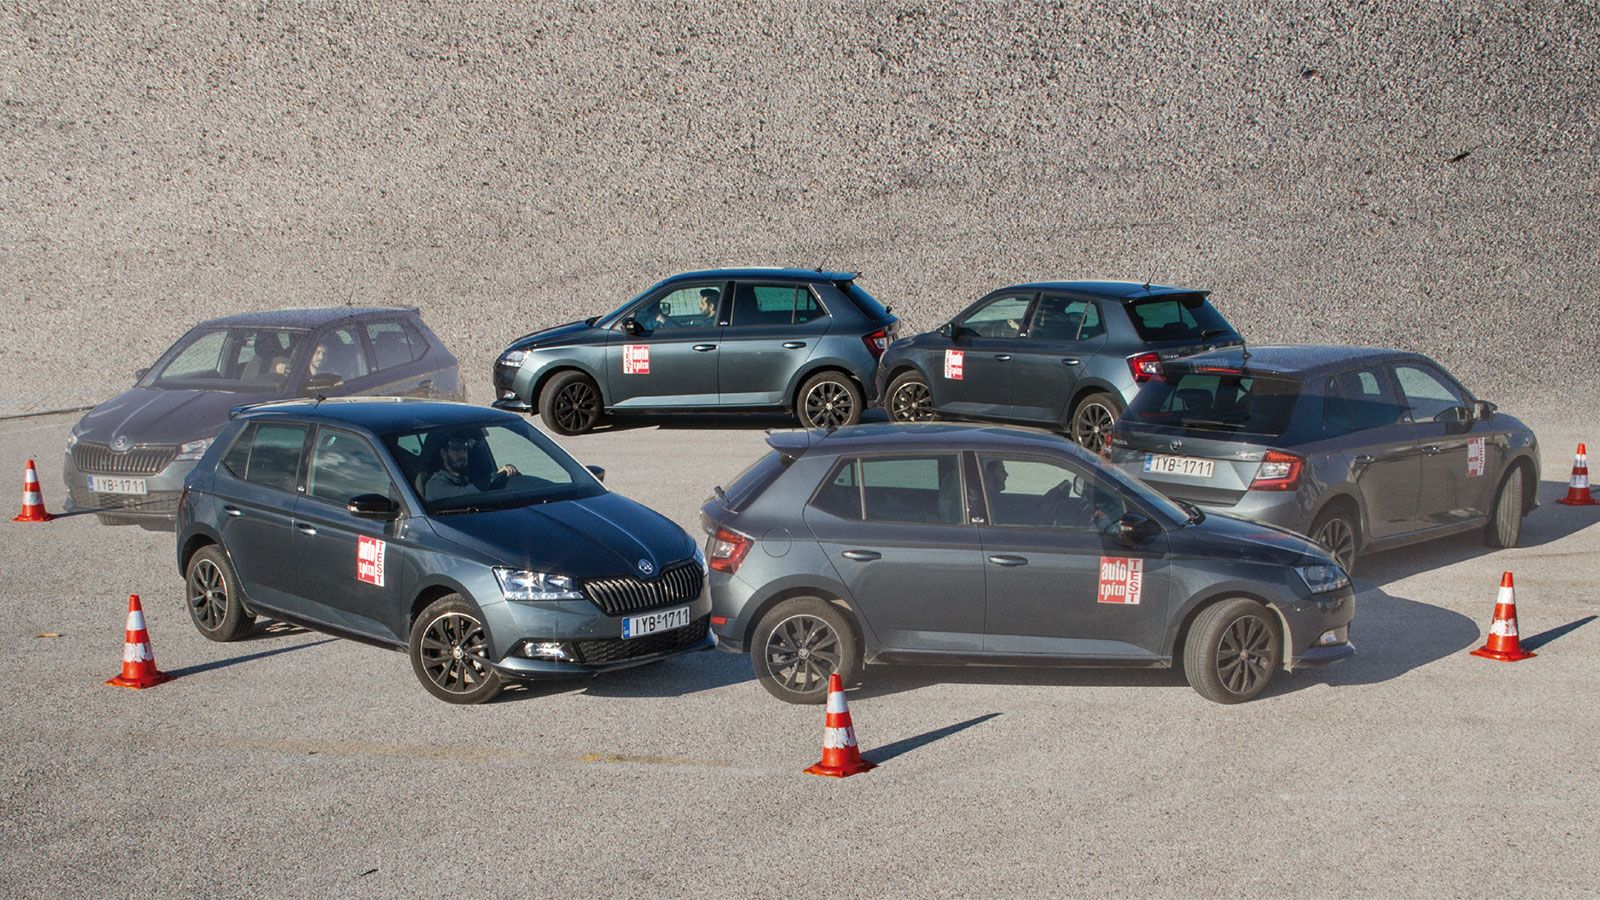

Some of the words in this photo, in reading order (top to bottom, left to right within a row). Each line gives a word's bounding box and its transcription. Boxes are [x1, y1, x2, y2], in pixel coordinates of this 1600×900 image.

[376, 541, 384, 584] TEST
[1101, 560, 1127, 581] auto
[1128, 559, 1140, 603] TEST
